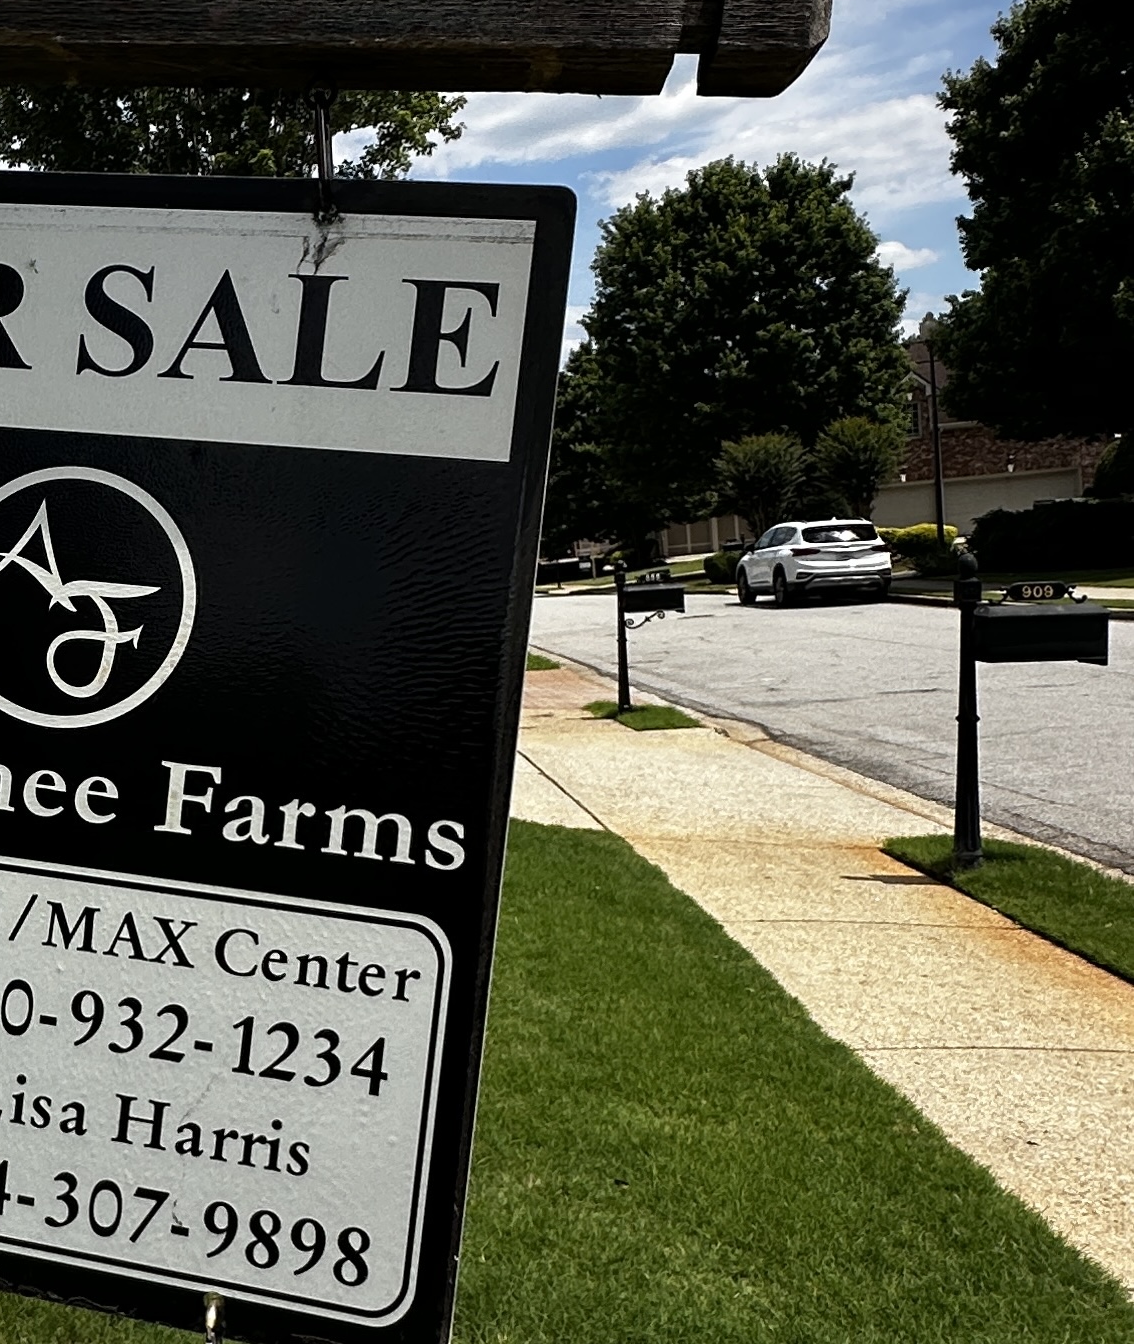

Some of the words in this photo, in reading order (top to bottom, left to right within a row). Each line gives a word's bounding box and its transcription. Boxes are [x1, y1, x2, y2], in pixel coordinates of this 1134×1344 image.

[76, 264, 501, 398] SALE
[153, 760, 467, 871] Farms
[214, 927, 421, 1003] Center
[110, 1093, 312, 1176] Harris
